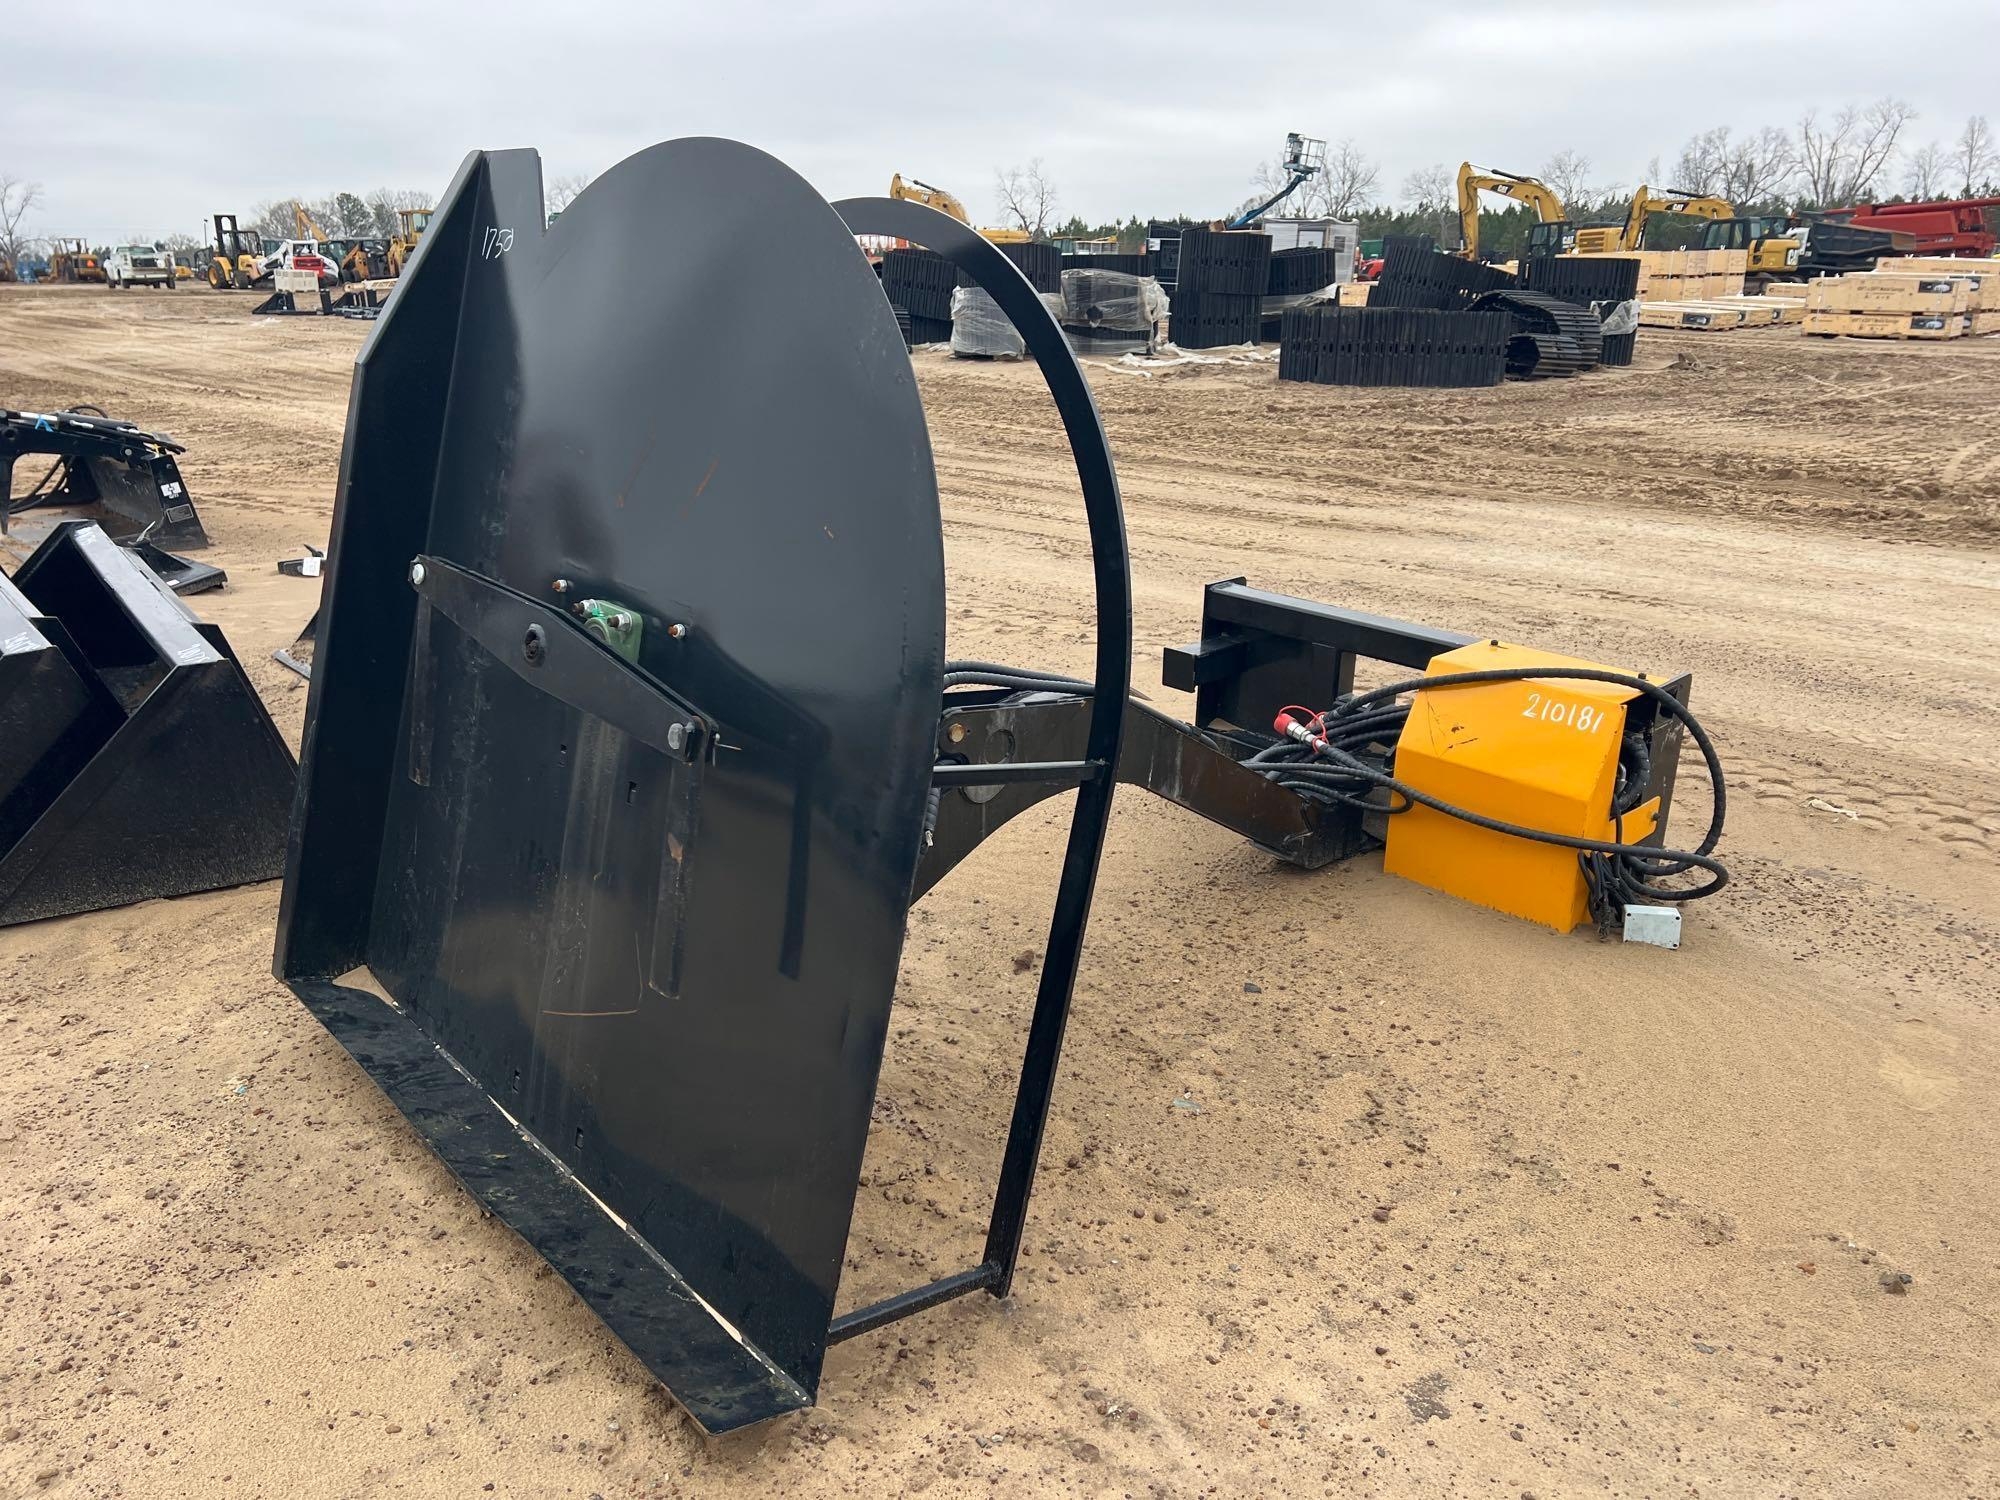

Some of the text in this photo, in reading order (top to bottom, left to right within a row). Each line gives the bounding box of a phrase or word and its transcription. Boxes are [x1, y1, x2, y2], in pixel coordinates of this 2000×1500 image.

[1497, 184, 1509, 194] CAT
[1672, 203, 1685, 211] CAT
[481, 225, 514, 260] 1750
[1562, 235, 1575, 244] CAT
[1522, 692, 1605, 734] 210181
